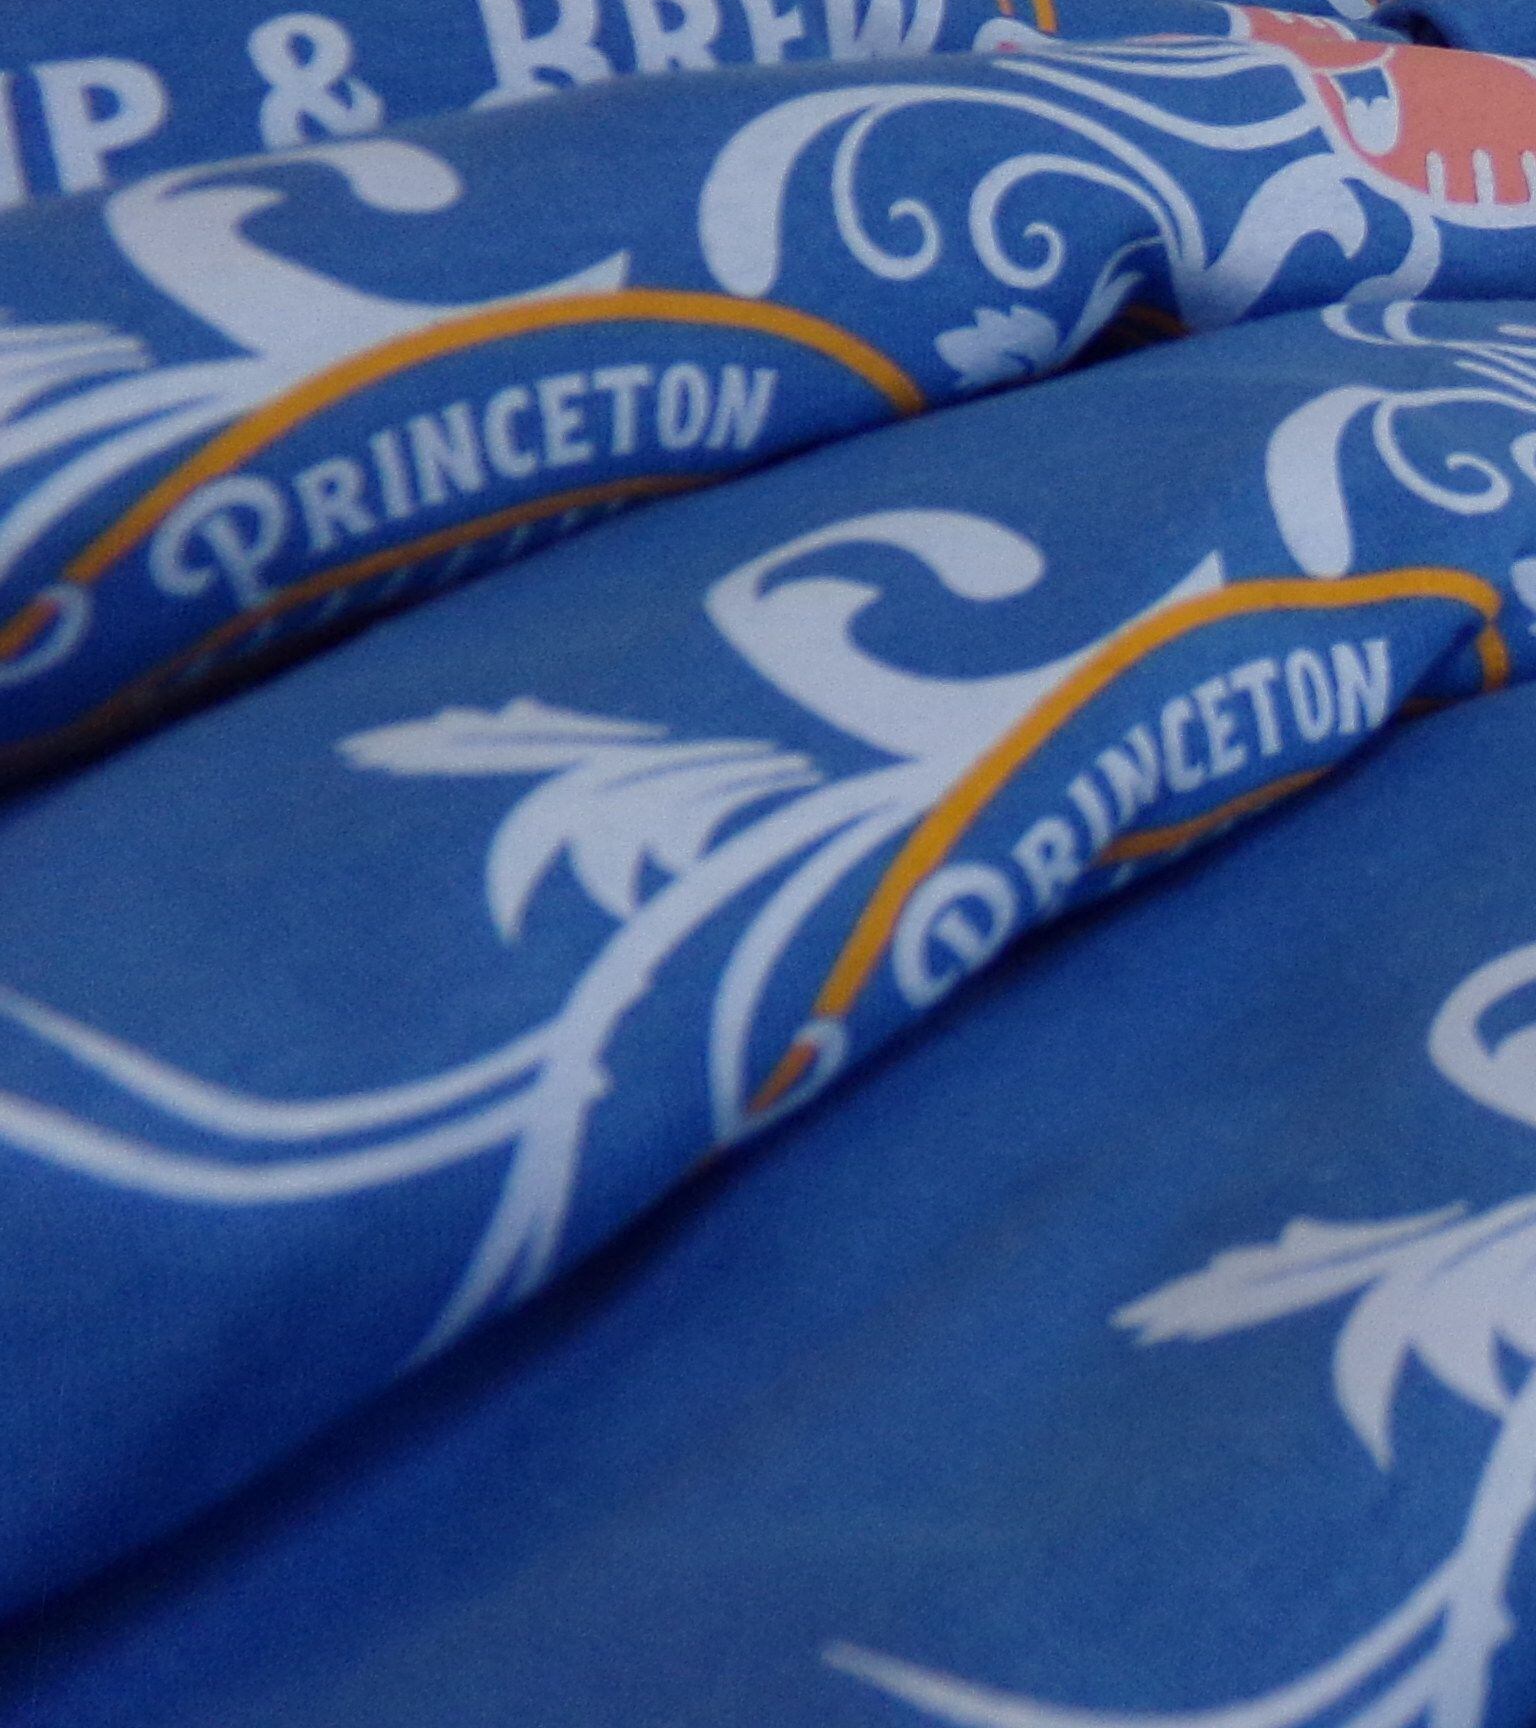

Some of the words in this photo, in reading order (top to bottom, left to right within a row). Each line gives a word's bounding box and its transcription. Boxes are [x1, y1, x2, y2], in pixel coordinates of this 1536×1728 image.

[247, 11, 384, 148] &
[147, 363, 779, 603] PRINCETON
[894, 637, 1394, 1010] PRINCETON
